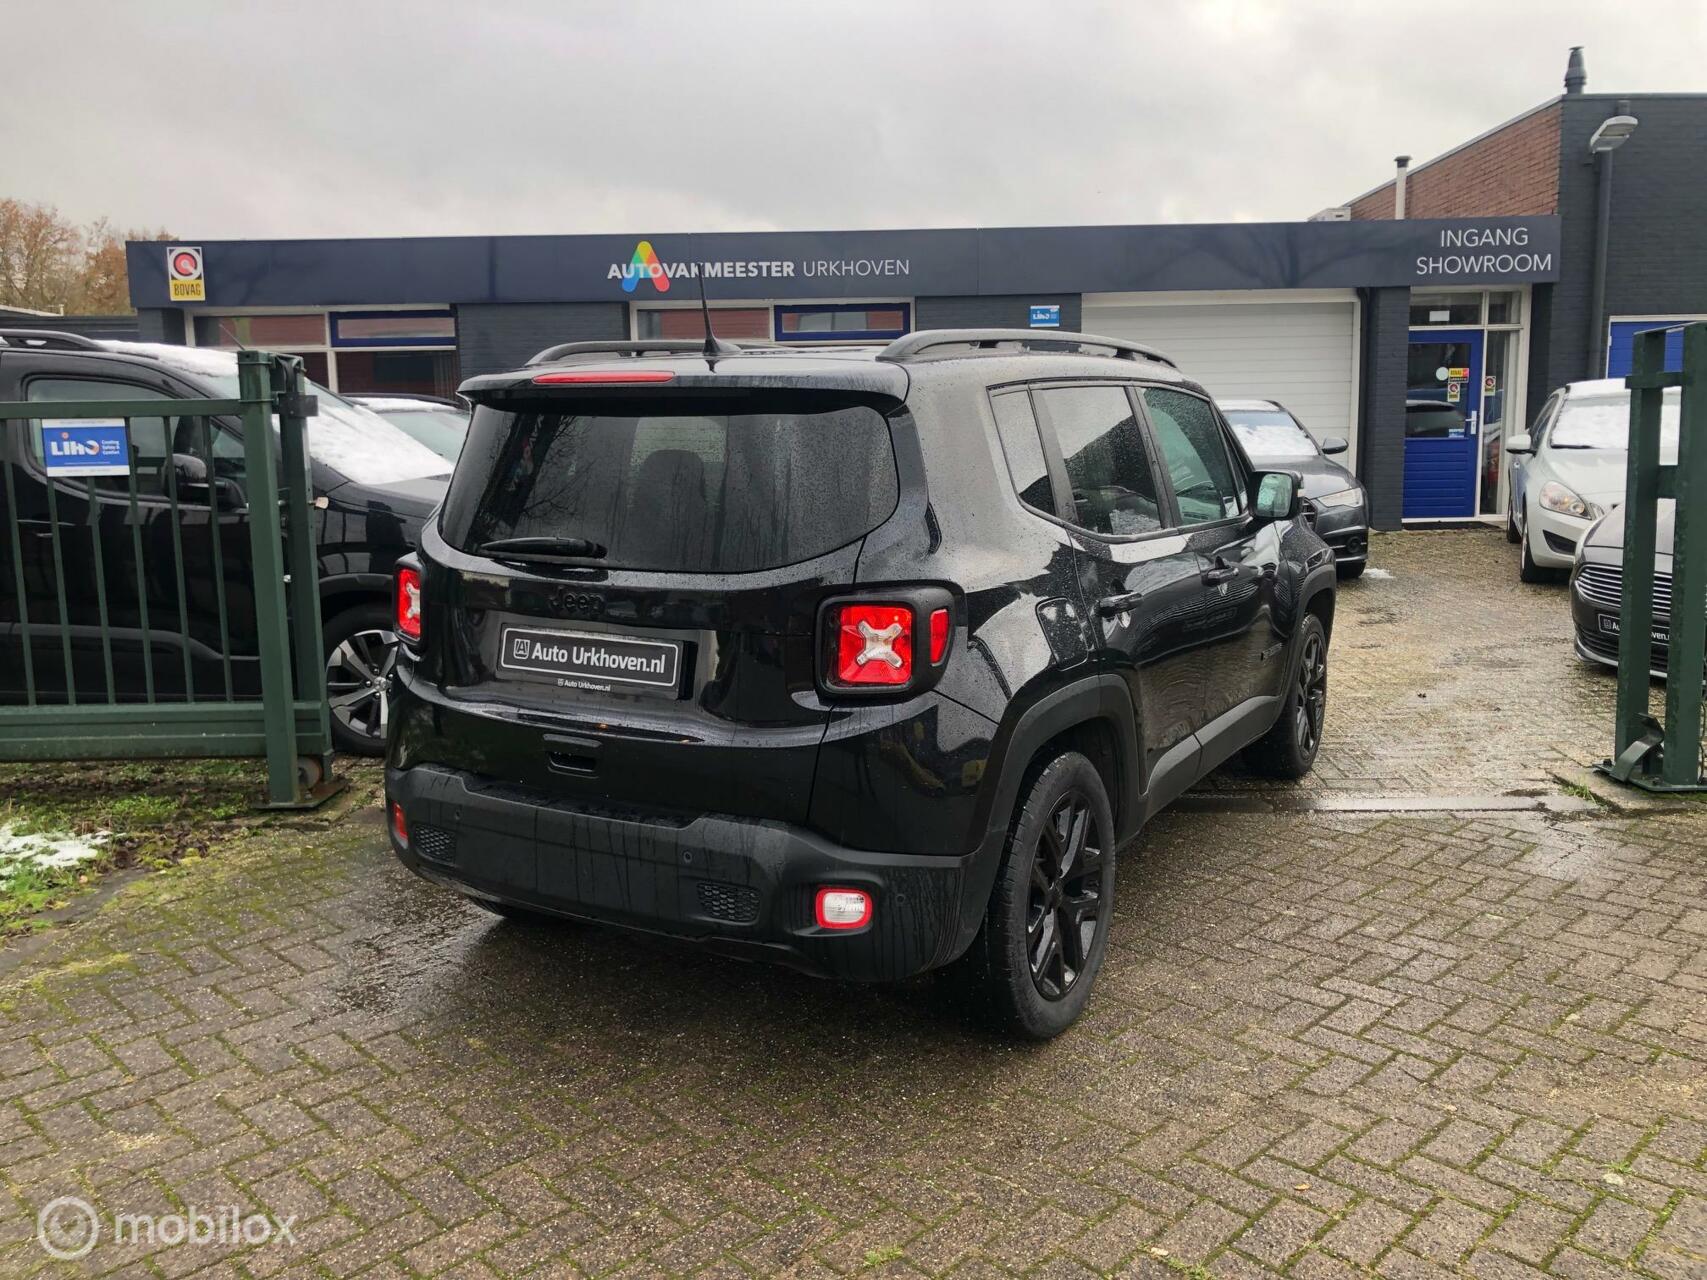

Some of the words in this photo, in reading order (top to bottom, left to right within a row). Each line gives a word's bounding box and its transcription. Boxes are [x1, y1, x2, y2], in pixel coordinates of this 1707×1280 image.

[1440, 227, 1529, 248] INGANG
[607, 260, 795, 280] AUTOVAKMEESTER
[802, 259, 910, 277] URKHOVEN
[1416, 253, 1552, 275] SHOWROOM
[173, 283, 201, 296] BOVAG
[531, 642, 568, 664] Auto
[572, 646, 666, 674] Urkhoven.nl
[564, 680, 578, 688] Auto
[578, 681, 611, 692] Urkhoven.nl
